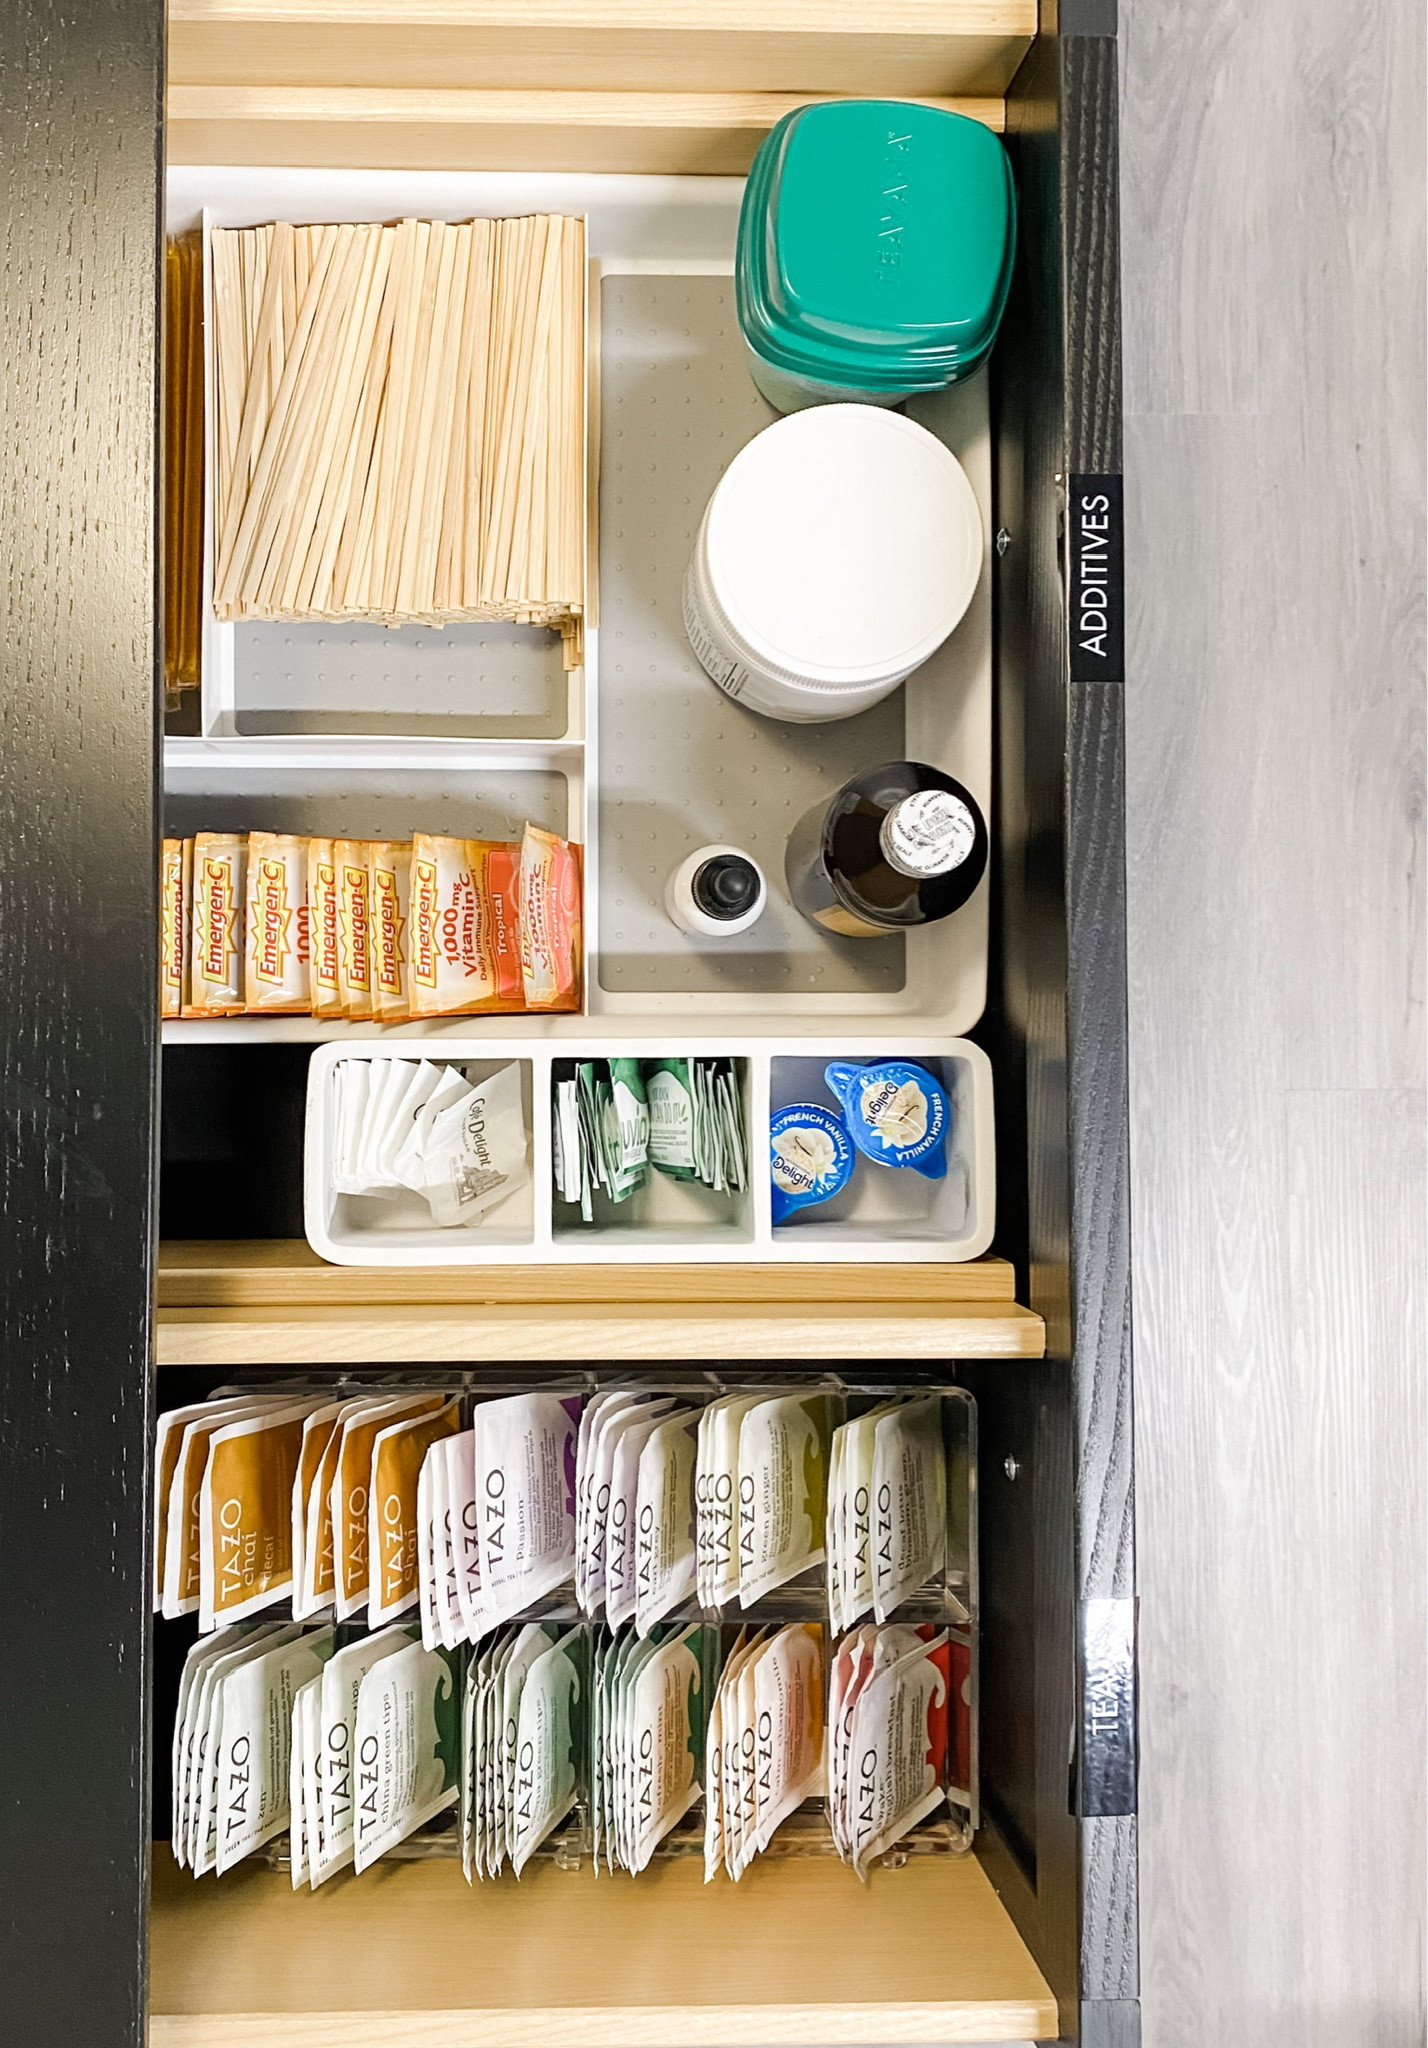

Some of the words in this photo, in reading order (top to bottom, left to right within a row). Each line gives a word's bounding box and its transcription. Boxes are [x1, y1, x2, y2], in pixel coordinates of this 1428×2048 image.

[1078, 494, 1109, 657] ADDITIVES
[205, 863, 227, 977] Emergen-C
[260, 864, 282, 977] Emergen-C
[320, 869, 336, 981] Emergen-C
[416, 866, 432, 979] Emergen-C
[442, 908, 460, 966] 1,000
[451, 882, 462, 907] mg
[459, 872, 471, 888] C
[492, 893, 507, 956] Tropical
[551, 887, 560, 949] Tropical
[347, 872, 368, 983] Emergen-C
[377, 874, 397, 987] Emergen-C
[460, 891, 478, 977] Vitamin
[475, 911, 484, 954] Immune
[478, 955, 488, 981] Daily
[468, 1120, 492, 1167] Delight
[783, 1111, 825, 1128] FRENCH
[824, 1120, 850, 1160] VANILLA
[895, 1135, 935, 1161] VANILLA
[930, 1092, 944, 1135] FRENCH
[772, 1156, 815, 1190] Delight
[762, 1465, 770, 1514] ginger
[902, 1453, 911, 1497] green
[220, 1498, 241, 1602] TAZO
[241, 1531, 257, 1586] chai
[261, 1536, 274, 1580] decaf
[347, 1486, 367, 1589] TAZO
[384, 1494, 404, 1599] TAZO
[403, 1527, 417, 1581] chai
[462, 1501, 481, 1604] TAZO
[486, 1469, 505, 1574] TAZO
[587, 1484, 611, 1587] TAZO
[610, 1497, 627, 1601] TAZO
[638, 1504, 653, 1607] TAZO
[715, 1474, 732, 1576] TAZO
[740, 1475, 755, 1578] TAZO
[761, 1519, 770, 1563] green
[853, 1487, 869, 1590] TAZO
[878, 1484, 892, 1587] TAZO
[898, 1528, 906, 1571] decaf
[626, 1561, 634, 1590] earl
[382, 1693, 392, 1725] tips
[535, 1699, 543, 1731] tips
[772, 1656, 783, 1747] chamomile
[886, 1693, 895, 1767] breakfast
[1090, 1680, 1119, 1737] TEA
[226, 1736, 249, 1840] TAZO
[328, 1722, 351, 1826] TAZO
[360, 1735, 379, 1840] TAZO
[384, 1728, 393, 1774] green
[516, 1741, 533, 1845] TAZO
[639, 1728, 653, 1833] TAZO
[741, 1727, 755, 1832] TAZO
[758, 1711, 772, 1816] TAZO
[257, 1792, 267, 1819] zen
[381, 1778, 391, 1823] china
[857, 1749, 877, 1848] TAZO
